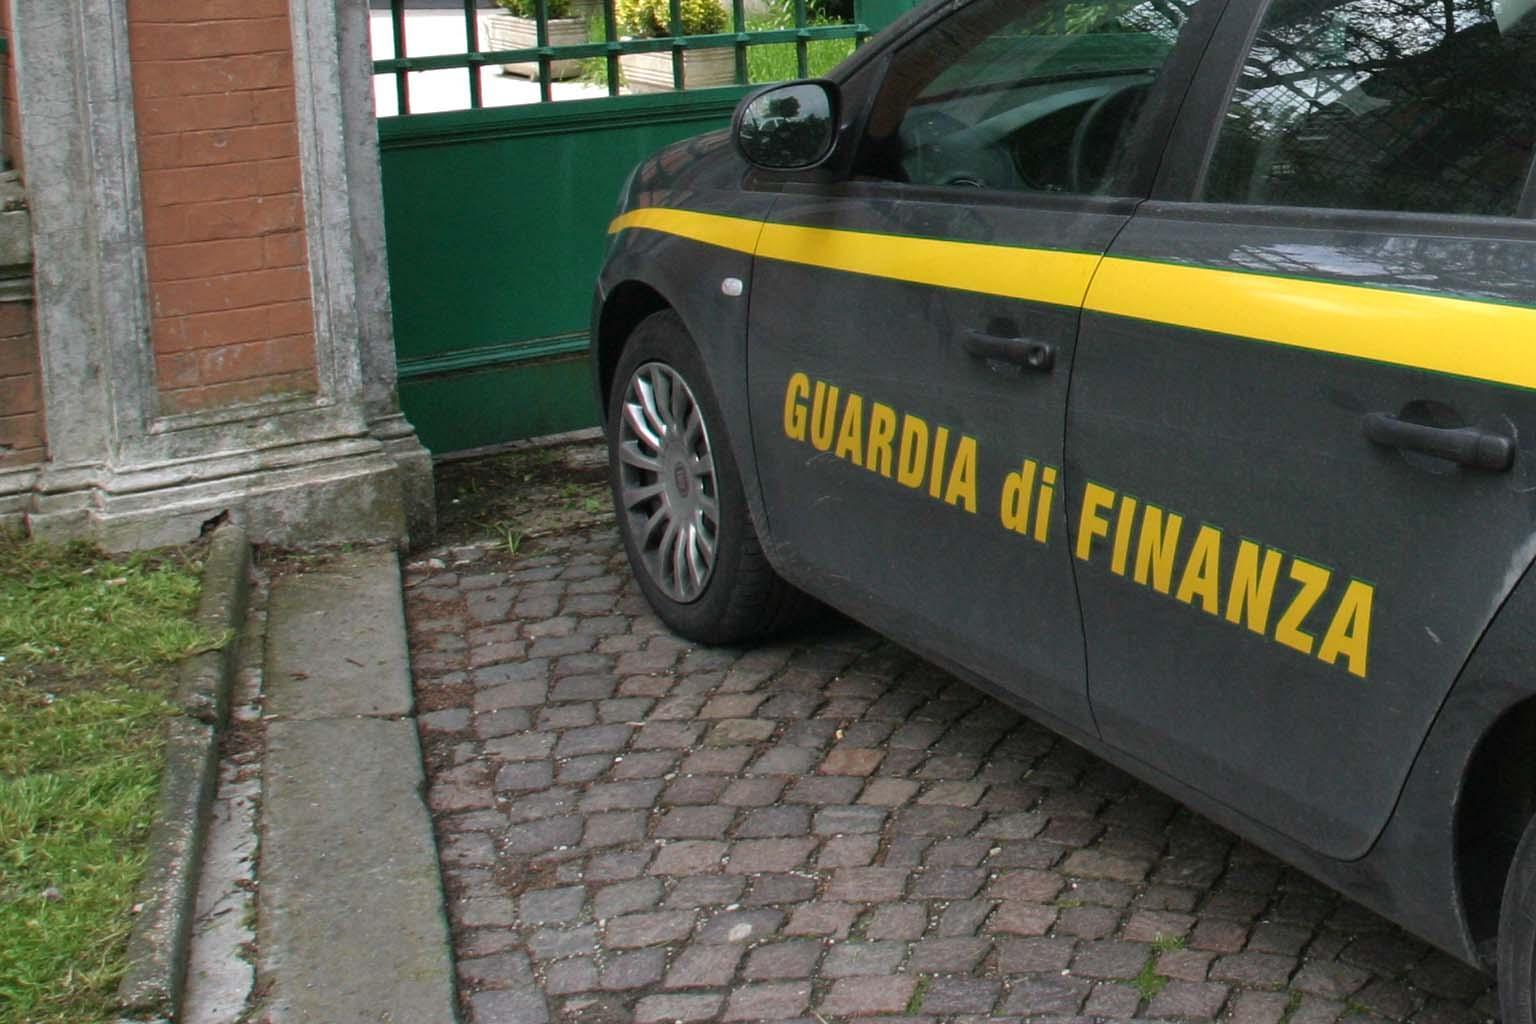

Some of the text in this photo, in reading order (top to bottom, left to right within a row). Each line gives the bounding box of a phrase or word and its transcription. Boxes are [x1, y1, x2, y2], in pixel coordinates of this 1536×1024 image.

[783, 372, 1376, 678] GUARDIA di FINANZA
